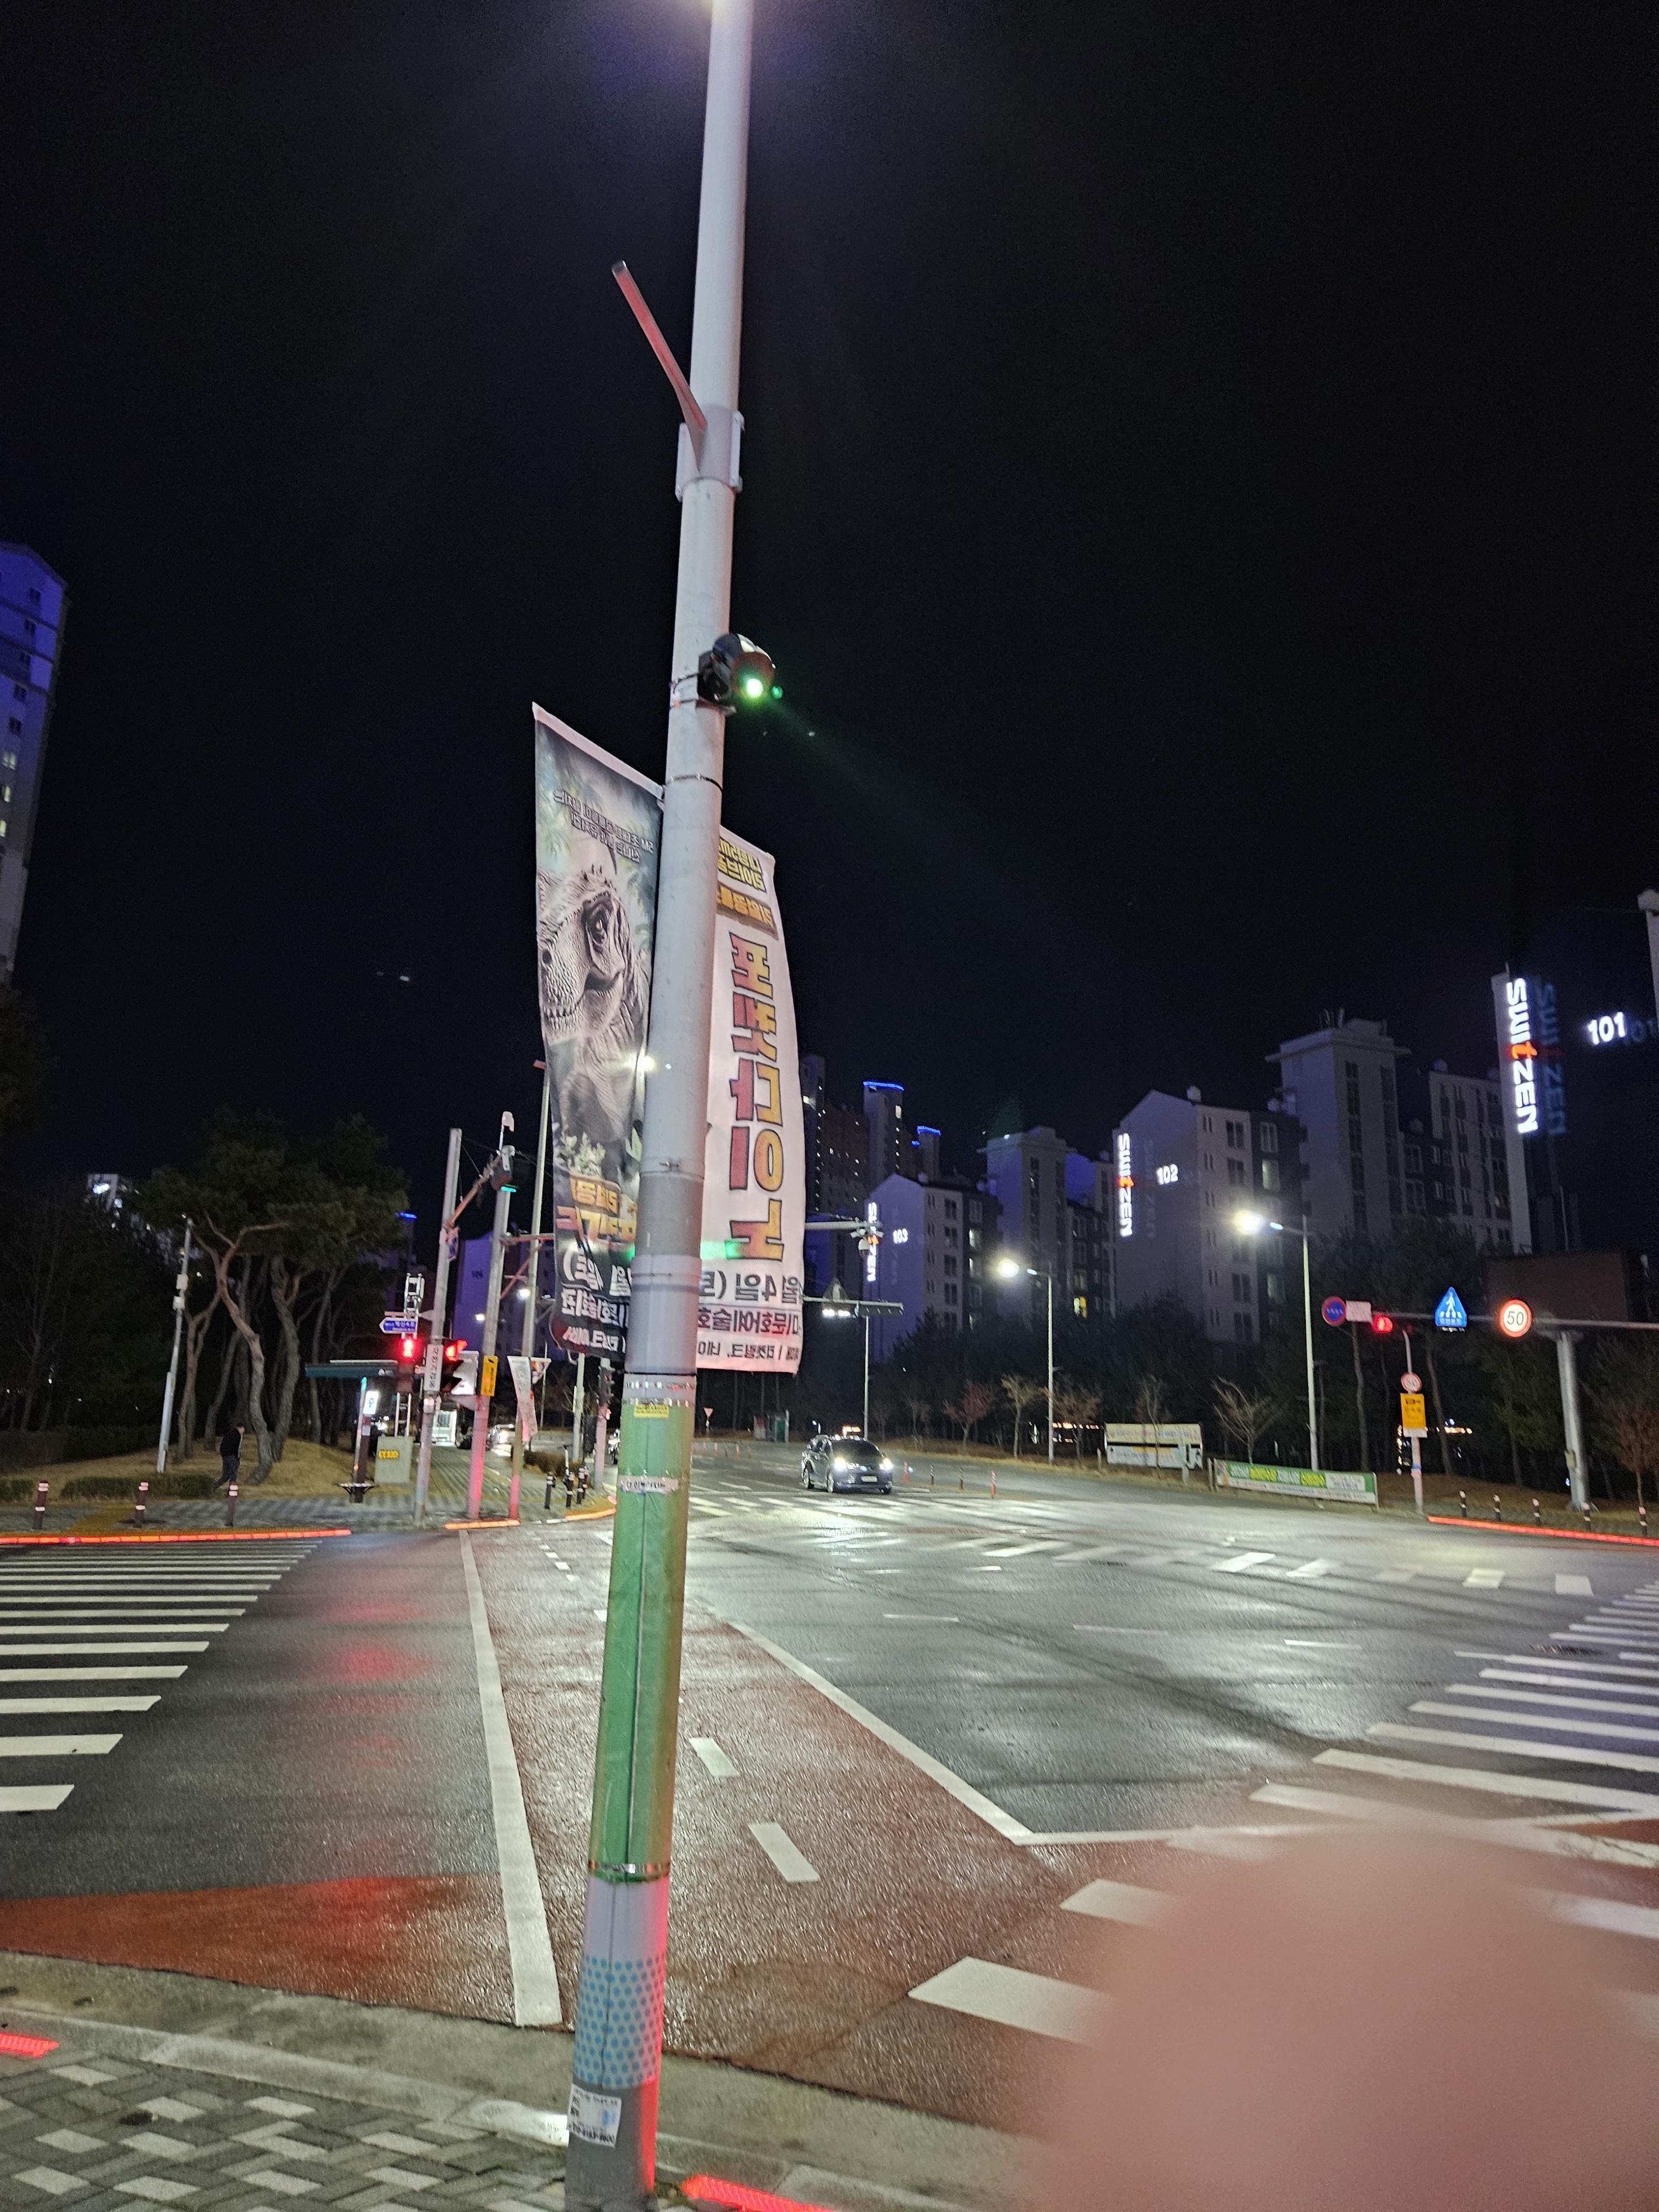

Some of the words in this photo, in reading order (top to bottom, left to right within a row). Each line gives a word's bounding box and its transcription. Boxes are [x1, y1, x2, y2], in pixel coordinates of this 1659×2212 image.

[1586, 1011, 1625, 1045] 101
[1156, 1164, 1178, 1185] 102
[893, 1228, 909, 1244] 103
[1507, 1311, 1524, 1326] 50
